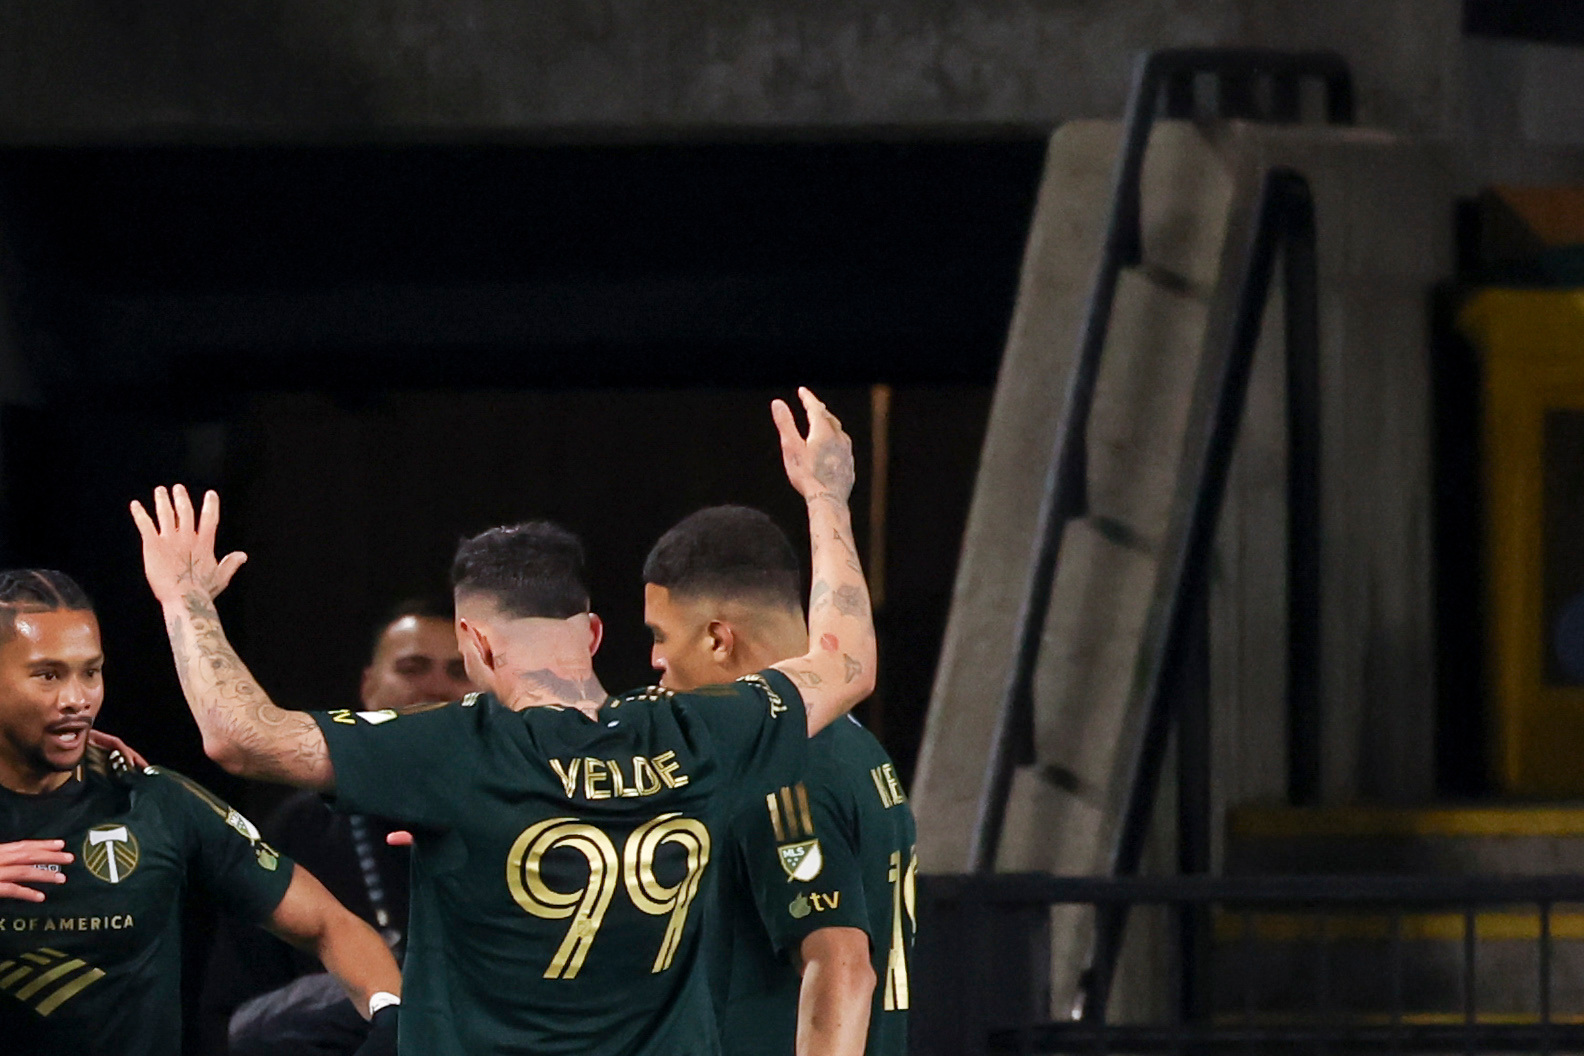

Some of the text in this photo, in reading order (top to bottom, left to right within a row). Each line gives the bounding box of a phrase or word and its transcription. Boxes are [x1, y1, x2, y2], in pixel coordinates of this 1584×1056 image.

[549, 750, 689, 799] VELDE
[782, 846, 805, 858] MLS
[506, 812, 711, 979] 99
[809, 891, 840, 912] tv
[13, 917, 38, 932] OF
[44, 914, 134, 931] AMERICA
